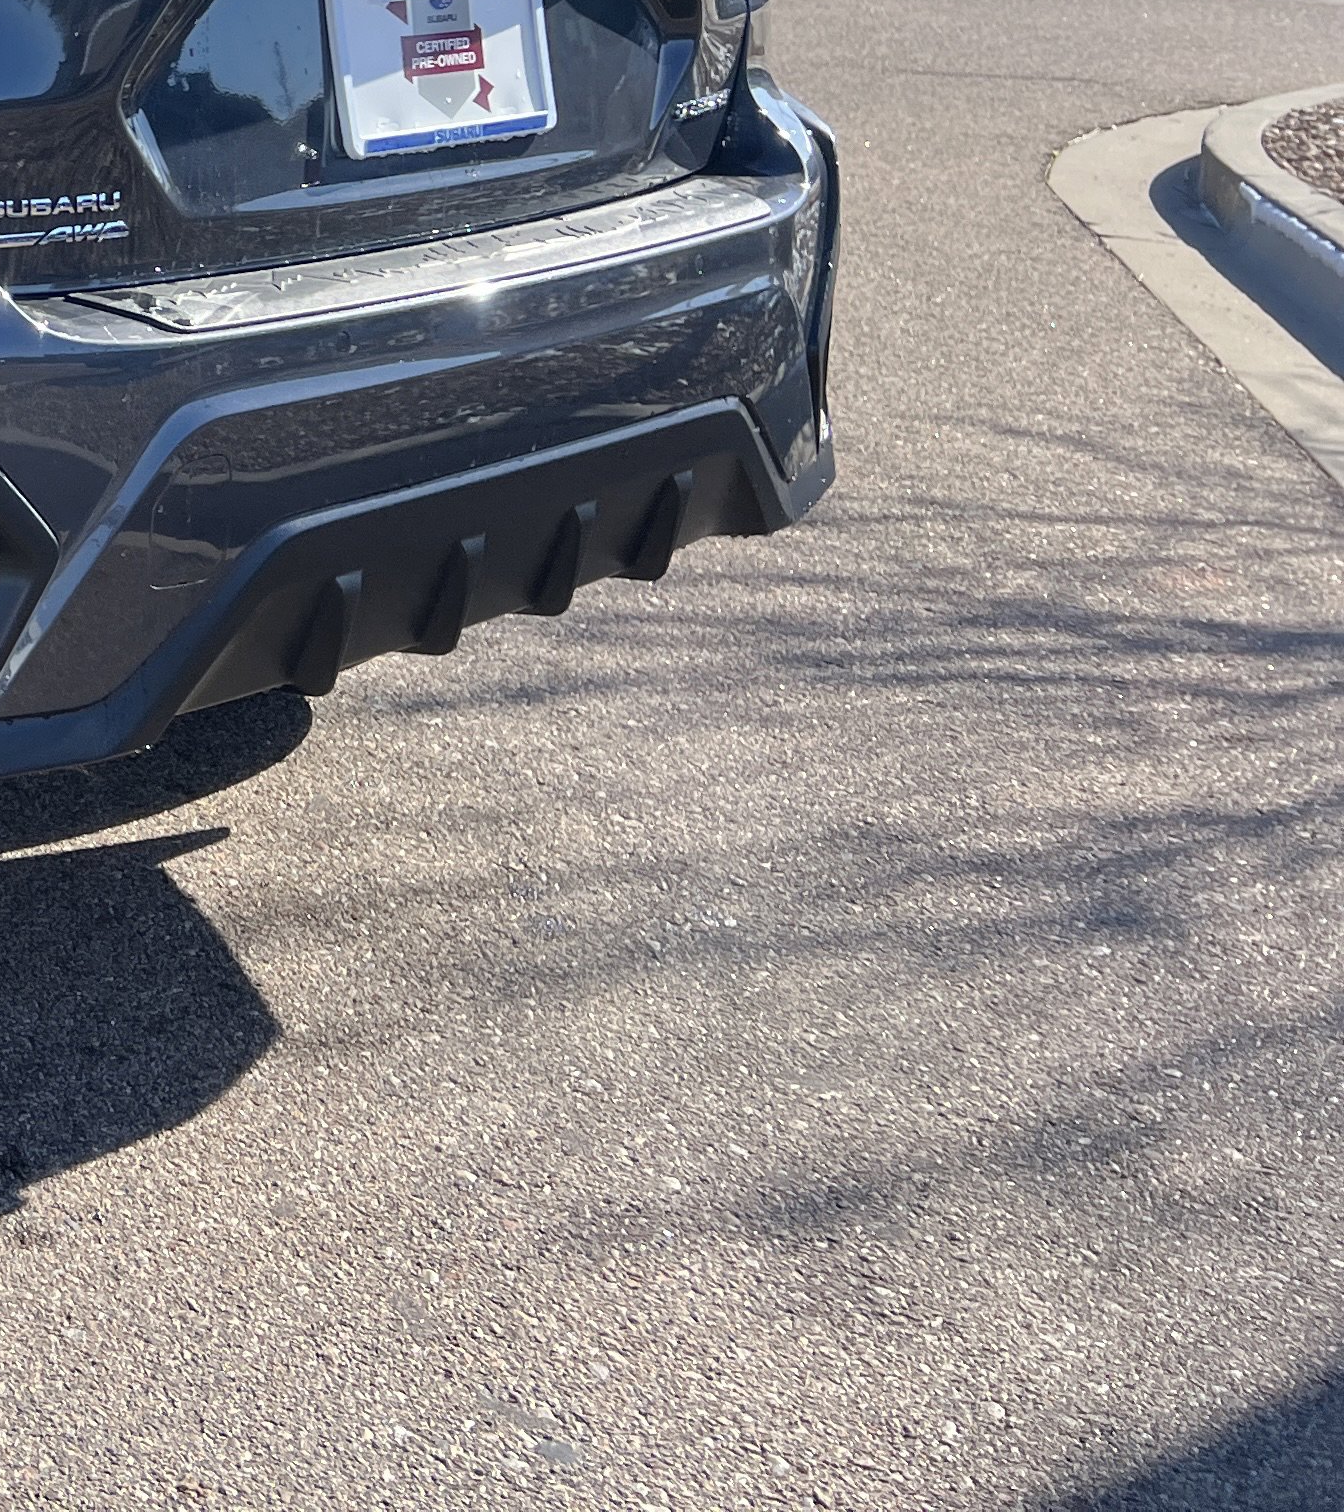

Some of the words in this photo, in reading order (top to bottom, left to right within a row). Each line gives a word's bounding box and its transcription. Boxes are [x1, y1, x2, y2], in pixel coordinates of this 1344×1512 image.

[426, 14, 458, 23] SUBARU
[416, 37, 470, 54] CERTIFIED
[412, 52, 477, 69] PRE-OWNED
[39, 221, 130, 245] AWD
